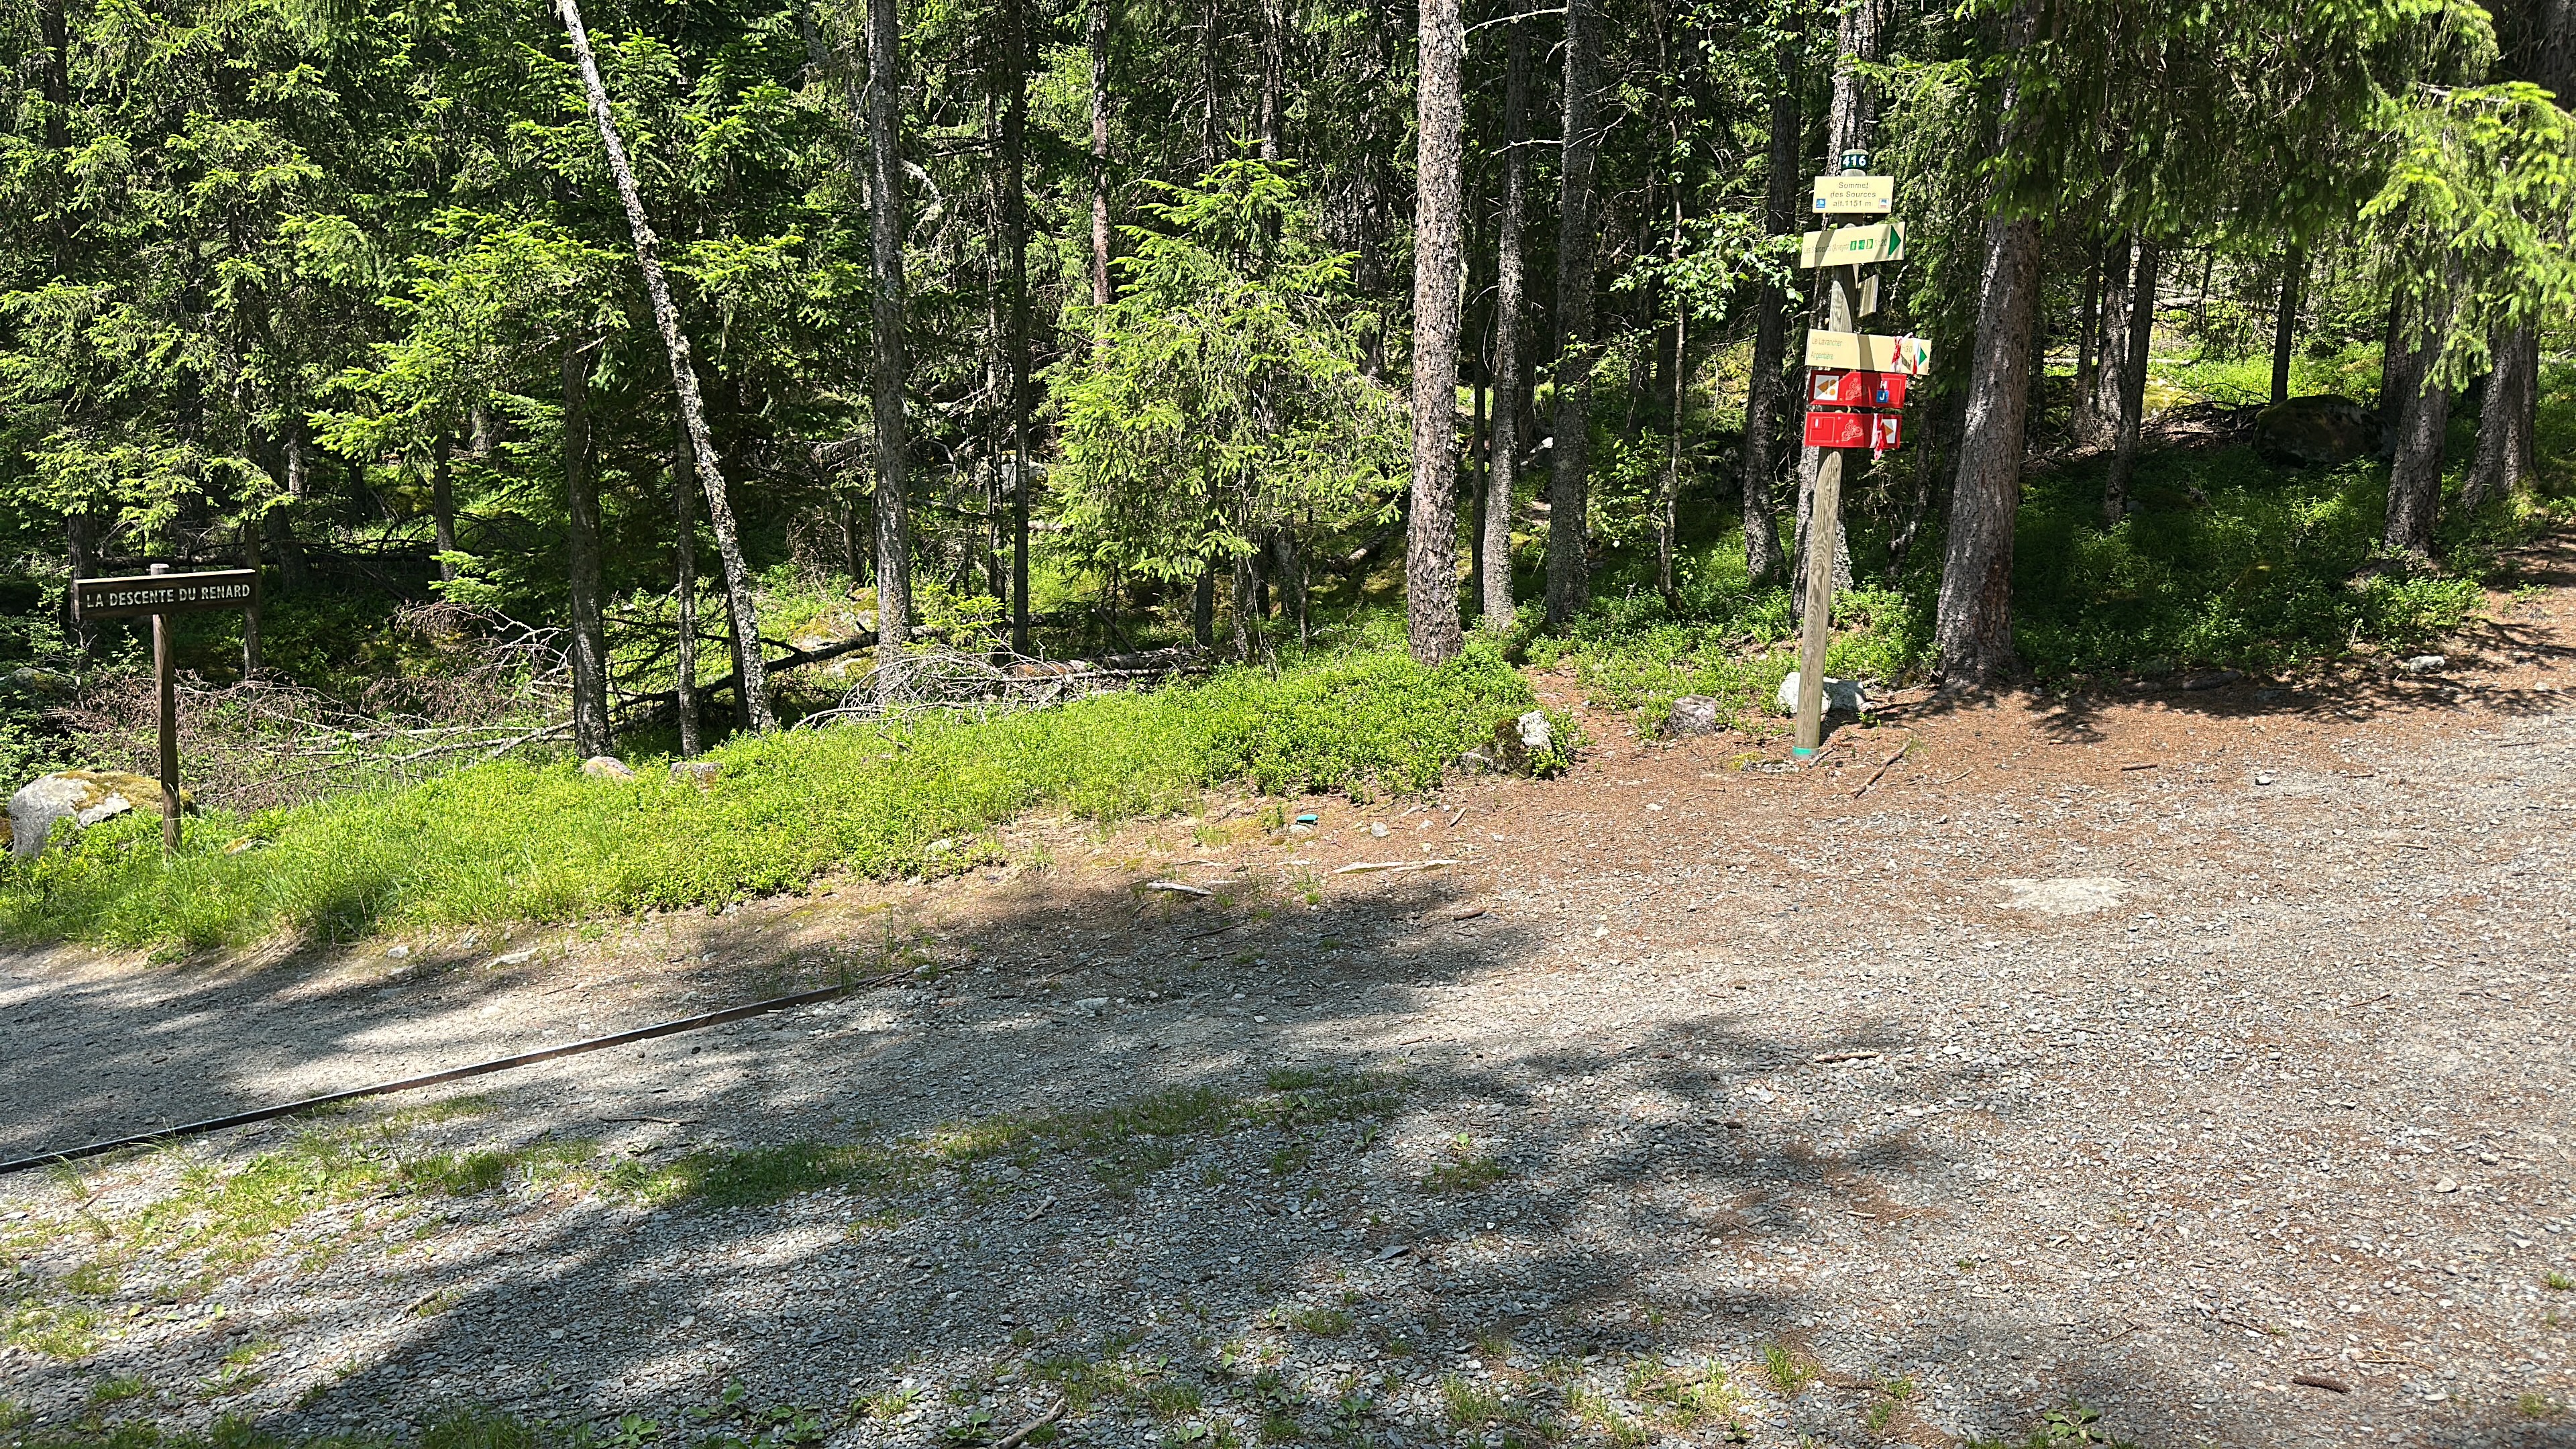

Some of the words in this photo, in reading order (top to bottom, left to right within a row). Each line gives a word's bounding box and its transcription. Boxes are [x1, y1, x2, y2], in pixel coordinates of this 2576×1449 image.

[1842, 155, 1866, 167] 416
[1819, 337, 1843, 347] Lavancher
[1879, 392, 1885, 400] J
[87, 594, 104, 608] LA
[109, 589, 174, 606] DESCENTE
[179, 587, 196, 601] DU
[201, 584, 250, 599] RENARD
